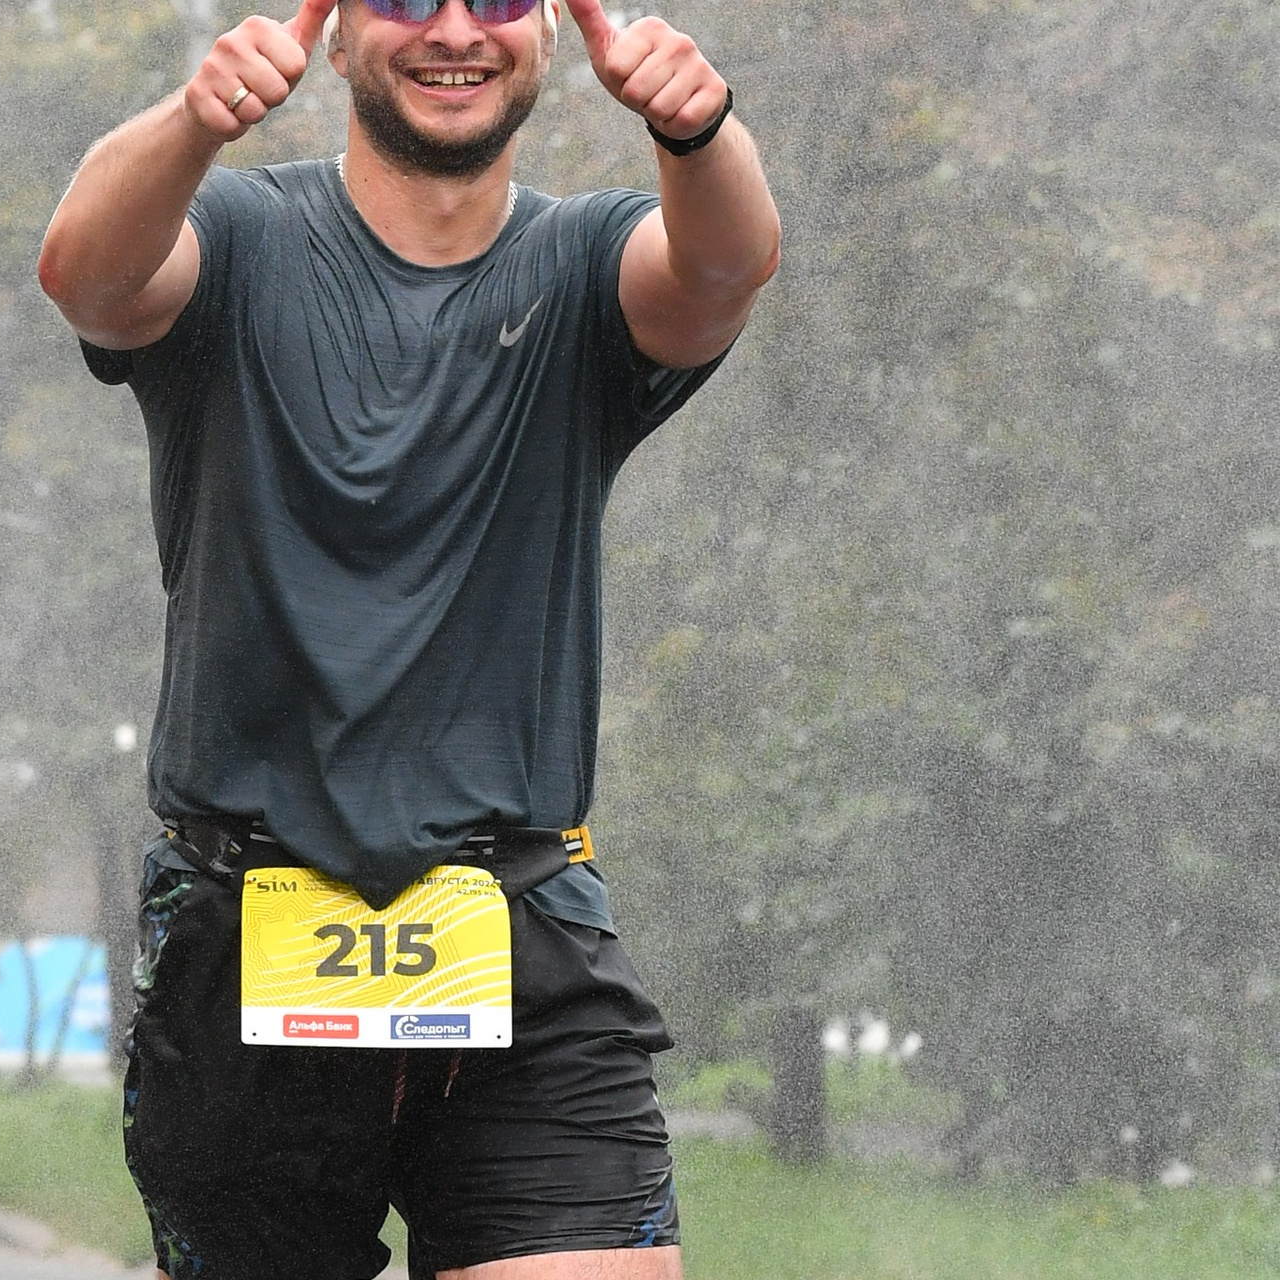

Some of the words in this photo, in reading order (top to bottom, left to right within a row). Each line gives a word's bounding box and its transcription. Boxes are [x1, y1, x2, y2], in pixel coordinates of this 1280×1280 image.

[418, 877, 469, 886] АВГУСТА
[313, 922, 437, 978] 215
[288, 1020, 324, 1033] Альфа
[325, 1021, 353, 1031] Банк
[403, 1023, 467, 1035] Следопыт
